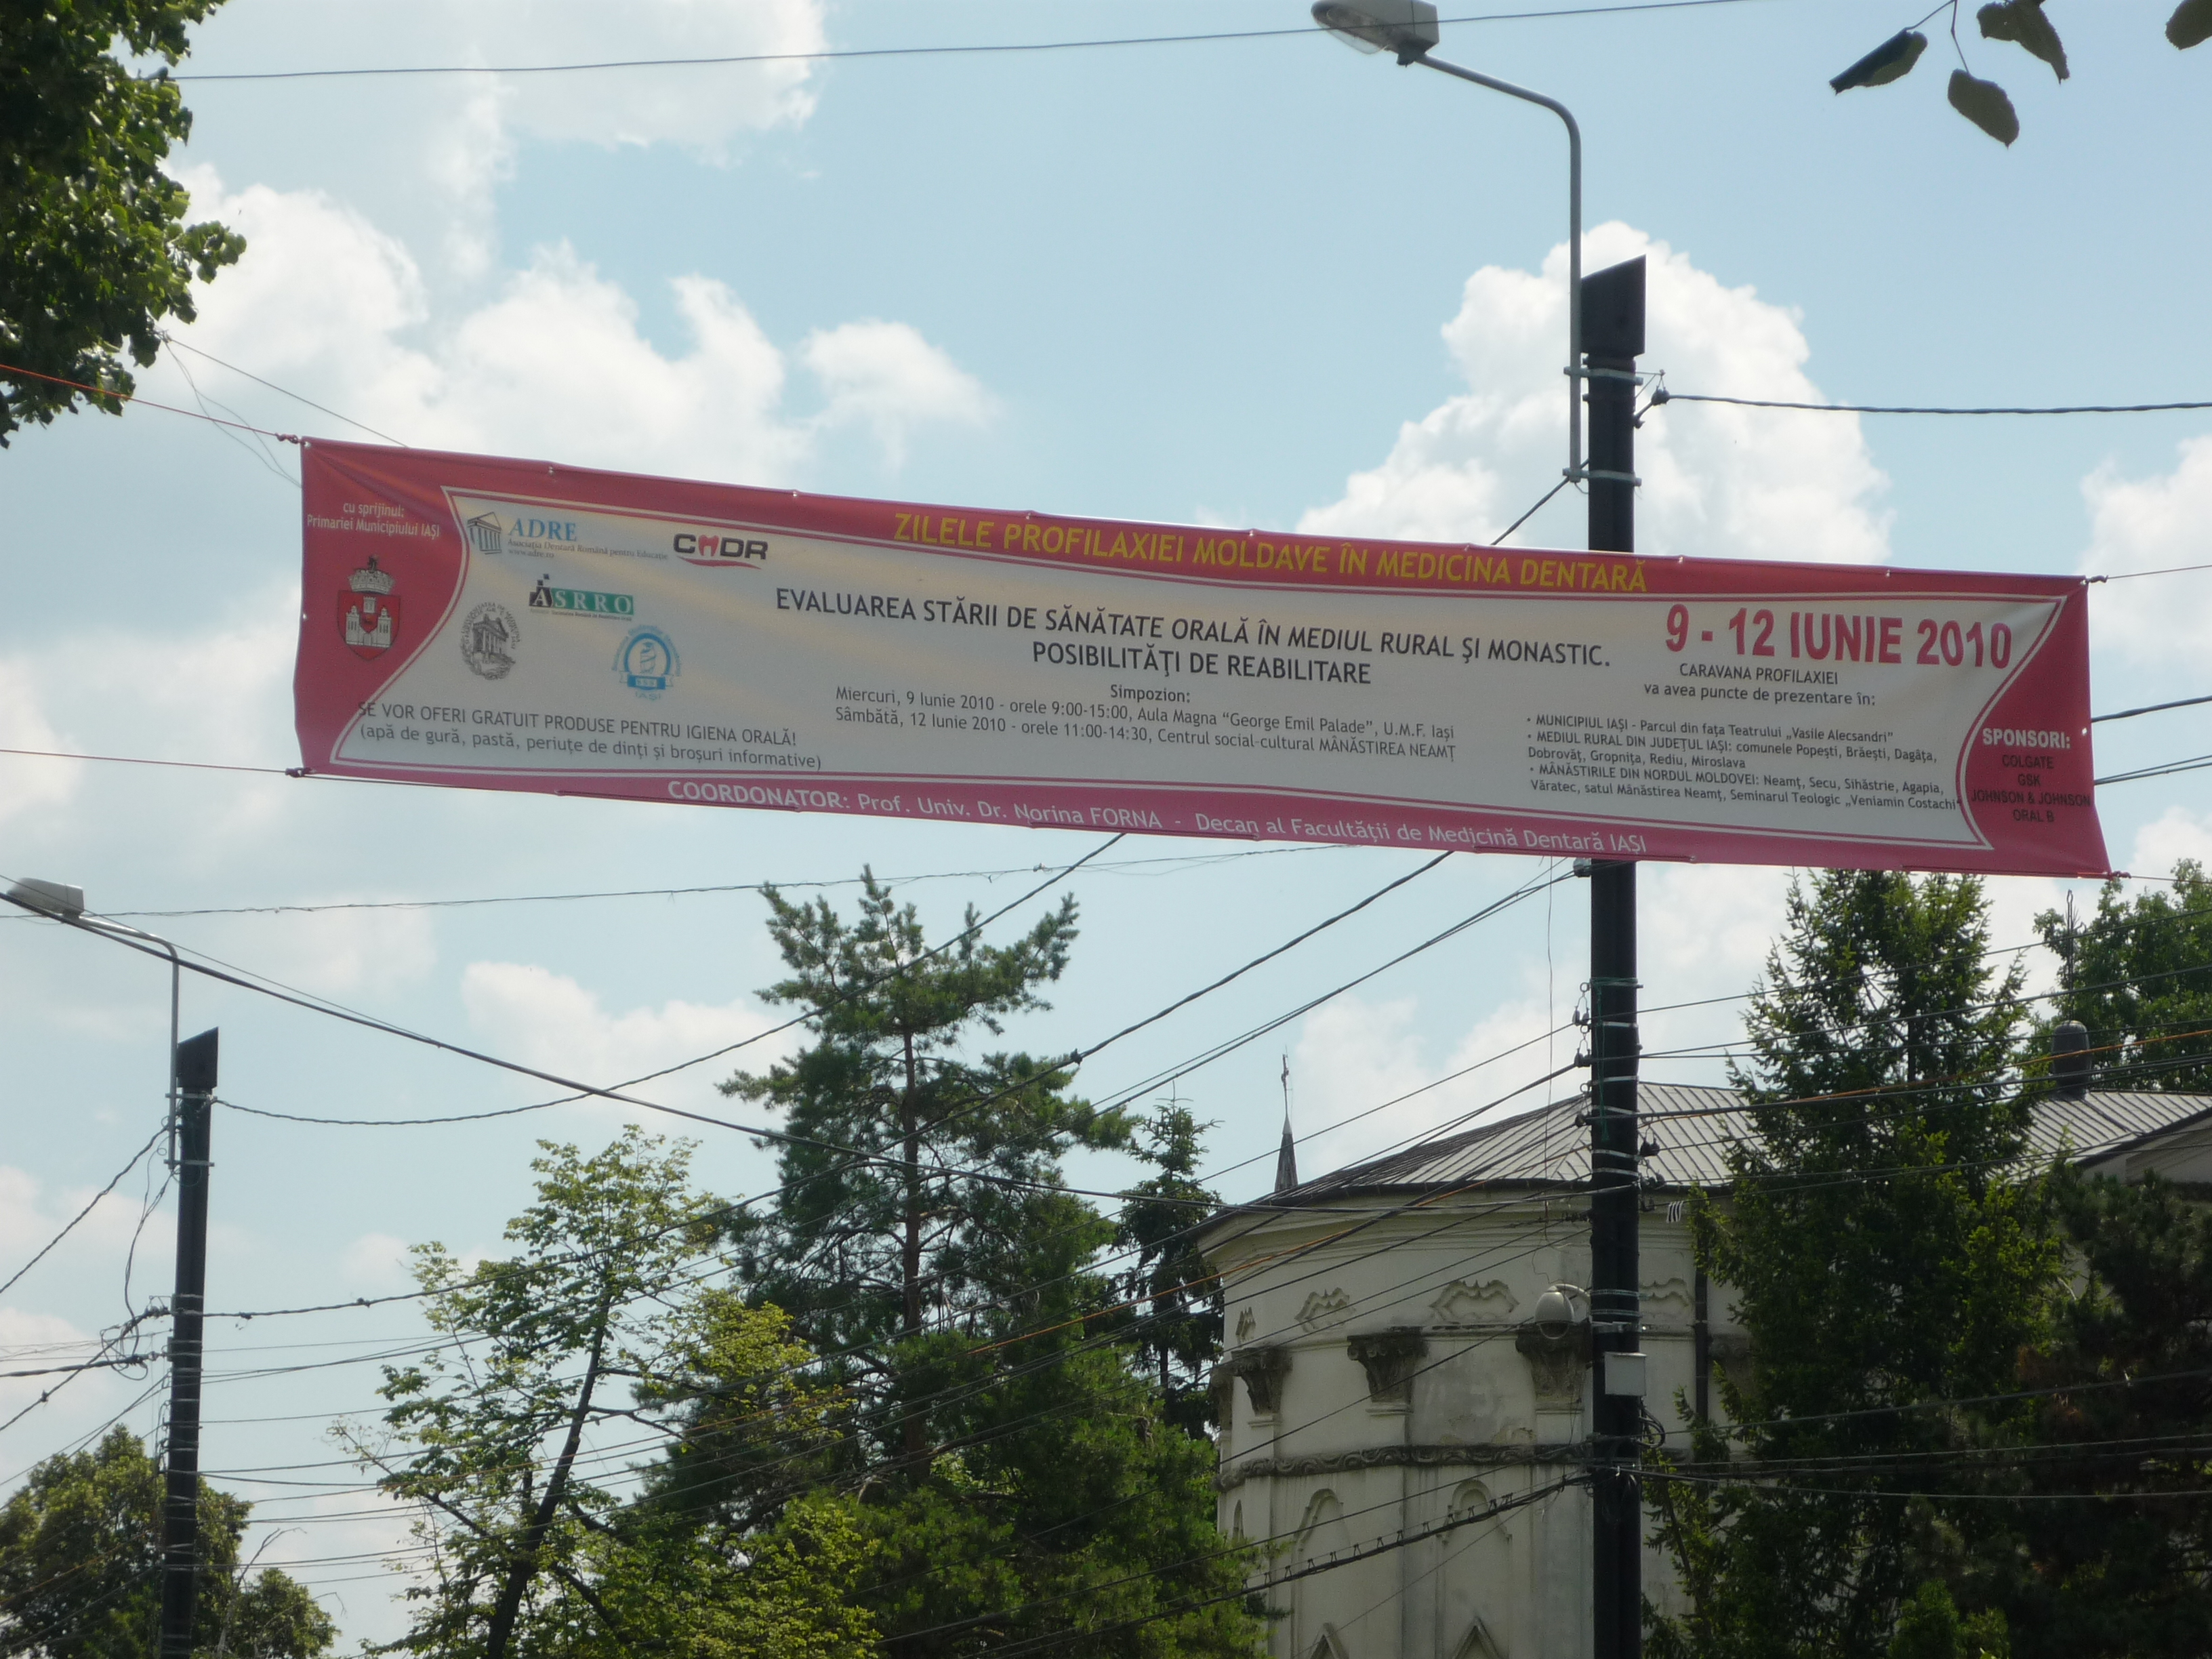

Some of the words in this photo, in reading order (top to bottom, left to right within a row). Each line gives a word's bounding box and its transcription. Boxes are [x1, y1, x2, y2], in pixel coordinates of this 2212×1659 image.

[343, 503, 355, 513] cu
[358, 503, 405, 518] sprijinul:
[307, 514, 353, 531] Primariei
[356, 518, 418, 537] Municipiului
[508, 518, 577, 541] ADRE
[610, 549, 634, 558] pentru
[893, 513, 994, 548] ZILELE
[1004, 523, 1183, 562] PROFILAXIEI
[1193, 537, 1330, 573] MOLDAVE
[1338, 543, 1368, 575] ÎN
[1376, 550, 1511, 583] MEDICINA
[1520, 559, 1647, 592] DENTARĂ
[531, 587, 632, 614] ASRRO
[776, 587, 916, 621] EVALUAREA
[924, 596, 997, 626] STĂRII
[1007, 606, 1036, 629] DE
[1046, 604, 1164, 638] SĂNĂTATE
[1172, 617, 1249, 644] ORALĂ
[1257, 619, 1281, 646] ÎN
[1288, 626, 1372, 652] MEDIUL
[1380, 632, 1454, 657] RURAL
[1488, 639, 1610, 667] MONASTIC.
[1666, 604, 1689, 652] 9
[1702, 630, 1714, 641] -
[1728, 607, 1776, 657] 12
[1789, 612, 1902, 665] IUNIE
[1917, 617, 2012, 670] 2010
[1190, 653, 1218, 676] DE
[1227, 655, 1371, 684] REABILITARE
[1679, 662, 1752, 681] CARAVANA
[1756, 667, 1838, 685] PROFILAXIEI
[1110, 684, 1191, 703] Simpozion:
[1644, 684, 1661, 697] va
[1664, 686, 1696, 698] avea
[1700, 685, 1748, 703] puncte
[1753, 687, 1771, 702] de
[1774, 690, 1852, 706] prezentare
[1856, 691, 1876, 705] în:
[358, 701, 376, 717] SE
[382, 703, 415, 720] VOR
[420, 706, 466, 723] OFERI
[472, 710, 539, 728] GRATUIT
[545, 714, 615, 733] PRODUSE
[621, 720, 681, 738] PENTRU
[687, 725, 737, 742] IGIENA
[741, 728, 797, 746] ORALĂ!
[836, 686, 901, 706] Miercuri,
[907, 691, 914, 704] 9
[920, 692, 956, 708] Iunie
[960, 695, 994, 711] 2010
[1009, 699, 1046, 715] orele
[1052, 701, 1132, 722] 9:00-15:00,
[1137, 707, 1168, 722] Aula
[1173, 709, 1217, 728] Magna
[1285, 716, 1315, 732] Emil
[1383, 722, 1426, 738] U.M.F.
[836, 706, 904, 727] Sâmbătă,
[910, 713, 926, 728] 12
[933, 714, 967, 730] Iunie
[972, 716, 1006, 733] 2010
[1021, 720, 1059, 736] orele
[1063, 722, 1152, 744] 11:00-14:30,
[1158, 729, 1210, 745] Centrul
[1214, 733, 1314, 752] social-cultural
[1319, 735, 1406, 756] MÂNĂSTIREA
[1536, 714, 1603, 729] MUNICIPIUL
[1641, 720, 1676, 733] Parcul
[1680, 722, 1698, 734] din
[1728, 724, 1782, 738] Teatrului
[361, 723, 394, 741] (apă
[401, 726, 419, 741] de
[426, 729, 466, 745] gură,
[472, 733, 520, 750] pastă,
[589, 739, 607, 754] de
[729, 750, 821, 771] informative)
[1537, 731, 1580, 743] MEDIUL
[1584, 733, 1622, 746] RURAL
[1626, 735, 1646, 747] DIN
[1736, 743, 1792, 755] comunele
[1983, 728, 2070, 749] SPONSORI:
[1650, 753, 1687, 766] Rediu,
[1692, 755, 1746, 769] Miroslava
[2002, 754, 2054, 769] COLGATE
[1539, 761, 1616, 779] MÂNĂSTIRILE
[1620, 768, 1639, 779] DIN
[1644, 769, 1692, 783] NORDUL
[1696, 771, 1759, 785] MOLDOVEI:
[1809, 777, 1841, 790] Secu,
[1844, 777, 1899, 794] Sihăstrie,
[1902, 781, 1944, 796] Agapia,
[2018, 773, 2041, 787] GSK
[1531, 779, 1580, 794] Văratec,
[1584, 783, 1613, 794] satul
[1617, 784, 1680, 798] Mânăstirea
[1730, 789, 1788, 803] Seminarul
[1793, 792, 1841, 806] Teologic
[1971, 790, 2024, 804] JOHNSON
[2028, 792, 2035, 804] &
[2039, 793, 2090, 806] JOHNSON
[668, 781, 849, 809] COORDONATOR:
[858, 793, 911, 813] Prof.
[918, 798, 970, 817] Univ.
[977, 800, 1006, 819] Dr.
[1014, 803, 1084, 823] Norina
[1091, 806, 1162, 828] FORNA
[1195, 813, 1260, 834] Decan
[1267, 817, 1284, 834] al
[1397, 824, 1421, 841] de
[1429, 825, 1518, 846] Medicină
[1523, 830, 1605, 851] Dentară
[2013, 809, 2043, 822] ORAL
[2047, 811, 2054, 822] B
